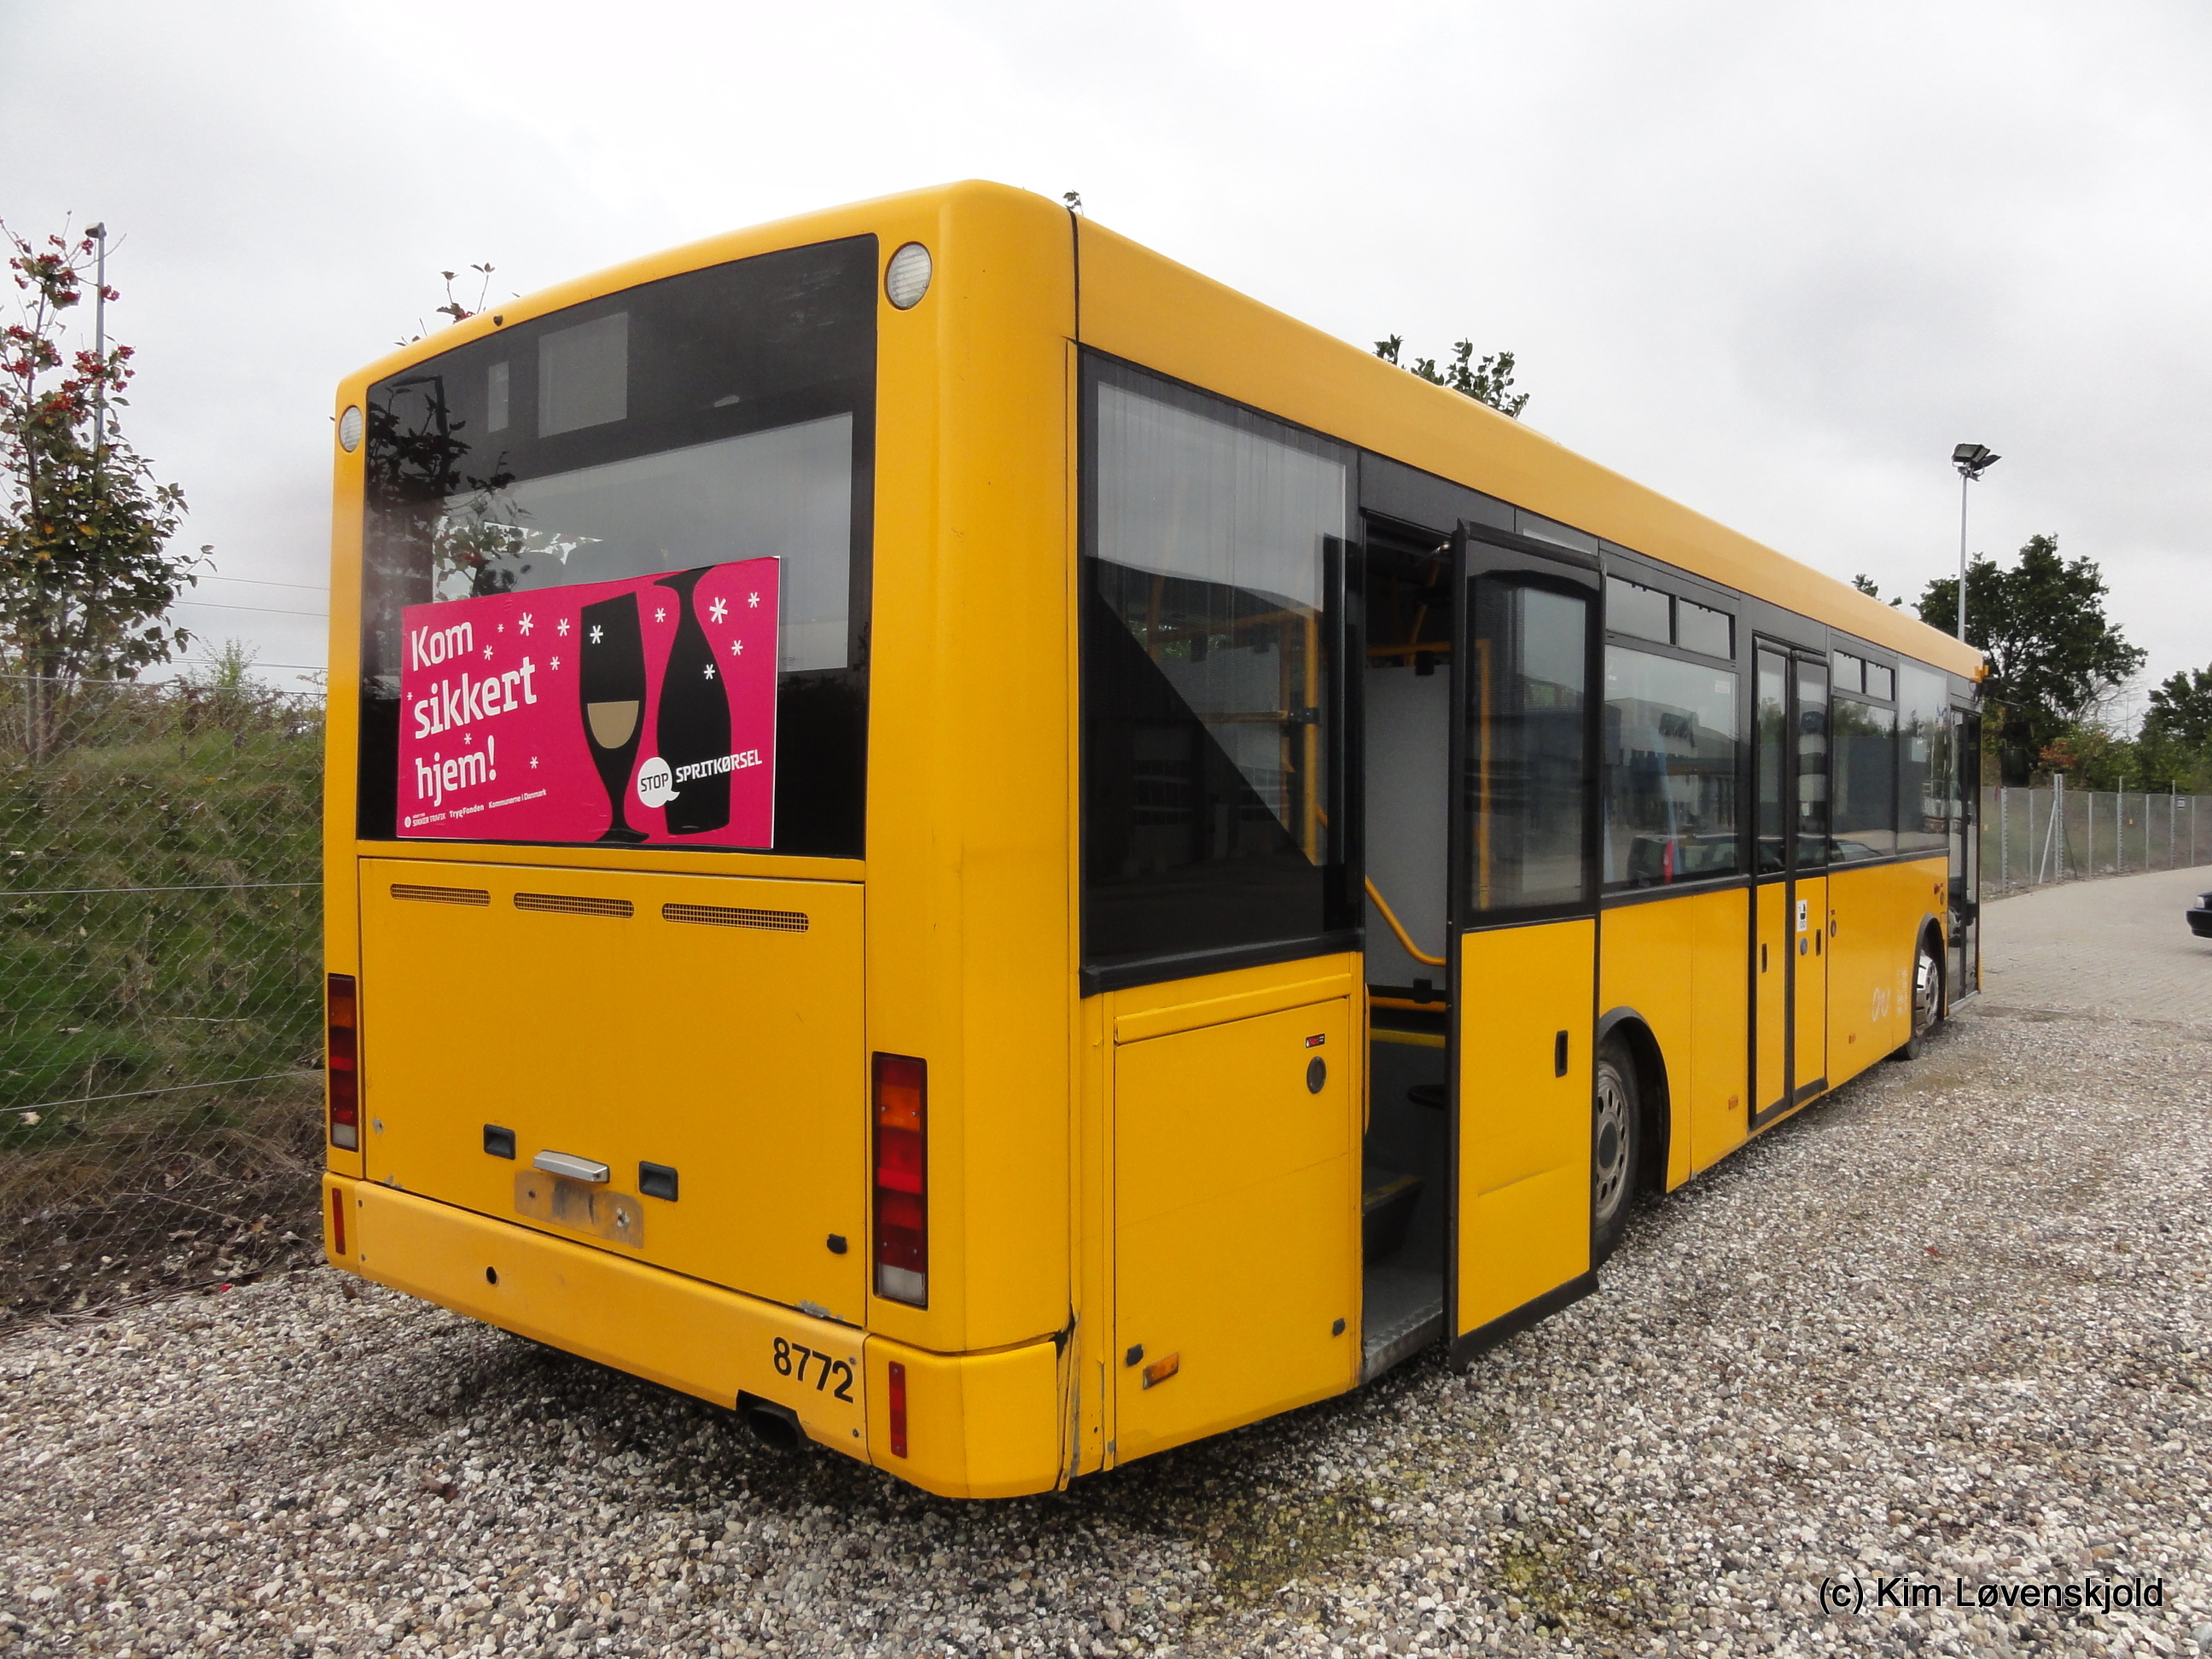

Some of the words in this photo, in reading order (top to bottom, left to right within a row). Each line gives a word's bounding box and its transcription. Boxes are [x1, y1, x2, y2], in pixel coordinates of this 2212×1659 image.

[410, 621, 474, 672] Kom
[414, 655, 538, 740] sikkert
[415, 735, 497, 807] hjem!
[524, 789, 546, 800] Danmark
[640, 772, 669, 792] STOP
[676, 748, 763, 783] SPRITKØRSEL
[450, 805, 484, 818] TrygFonden
[773, 1336, 853, 1404] 8772
